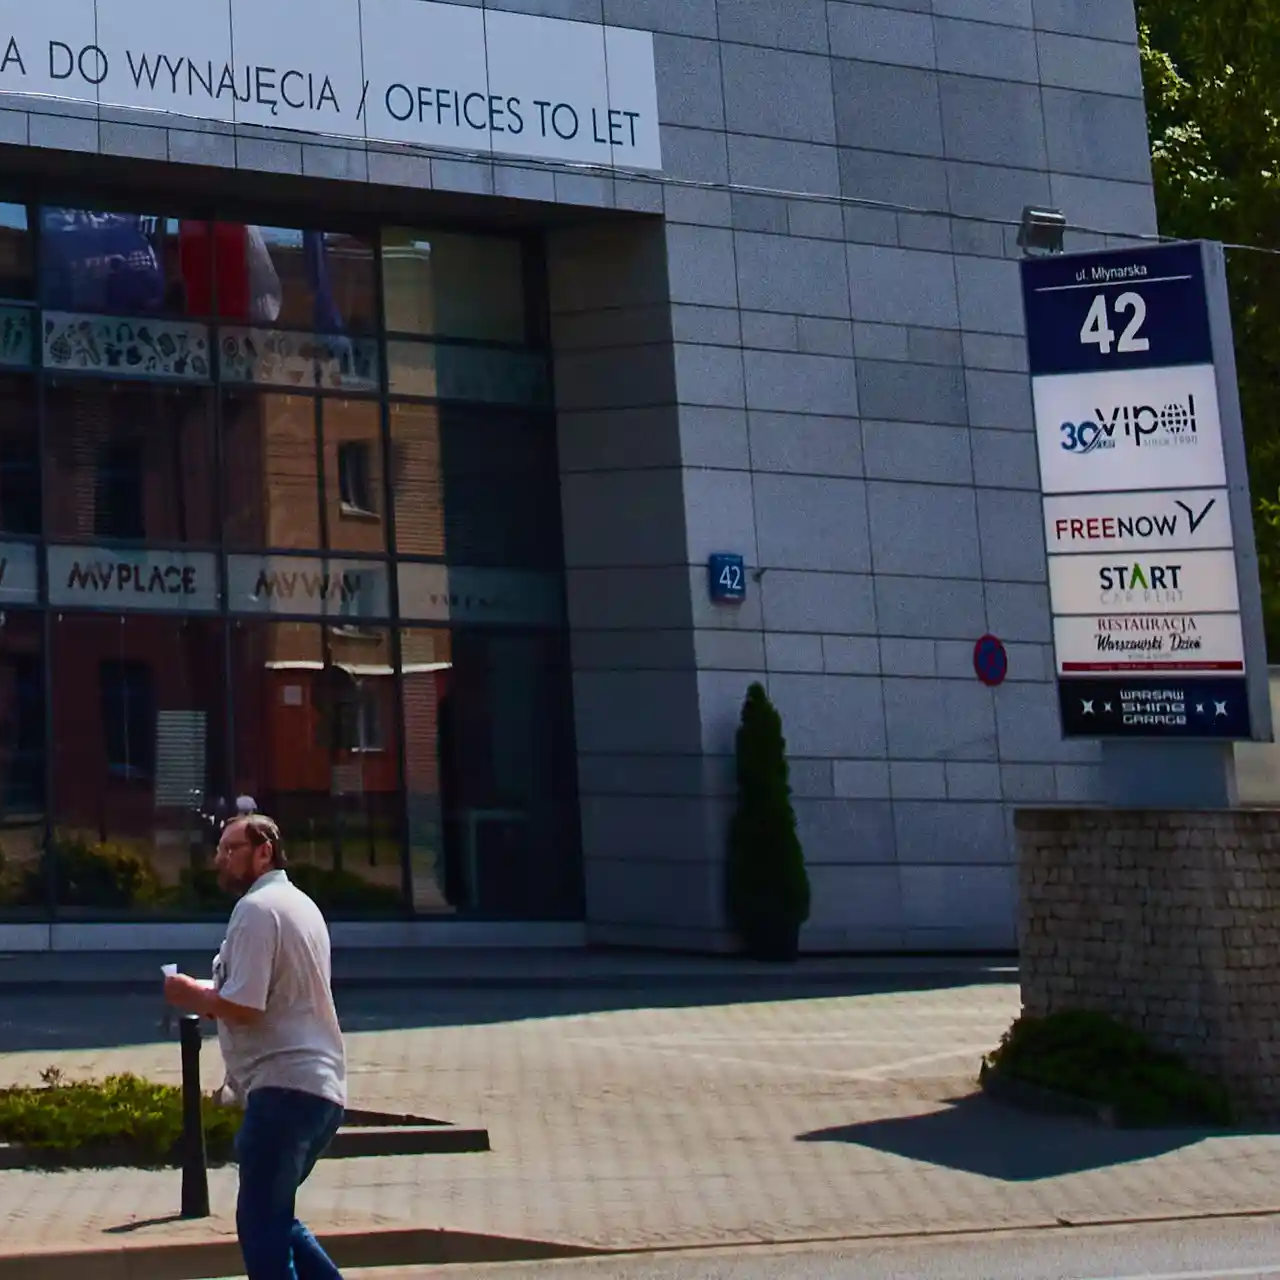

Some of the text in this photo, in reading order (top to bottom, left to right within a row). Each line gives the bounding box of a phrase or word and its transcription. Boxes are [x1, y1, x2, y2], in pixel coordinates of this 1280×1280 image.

[48, 39, 109, 86] DO
[126, 49, 341, 116] WYNAJĘCIA
[384, 81, 524, 135] OFFICES
[532, 100, 579, 141] TO
[591, 107, 642, 148] LET
[1075, 263, 1149, 283] ul. Młynarska
[1079, 291, 1151, 355] 42
[1055, 514, 1177, 541] FREENOW
[719, 565, 742, 590] 42
[1099, 561, 1182, 591] START
